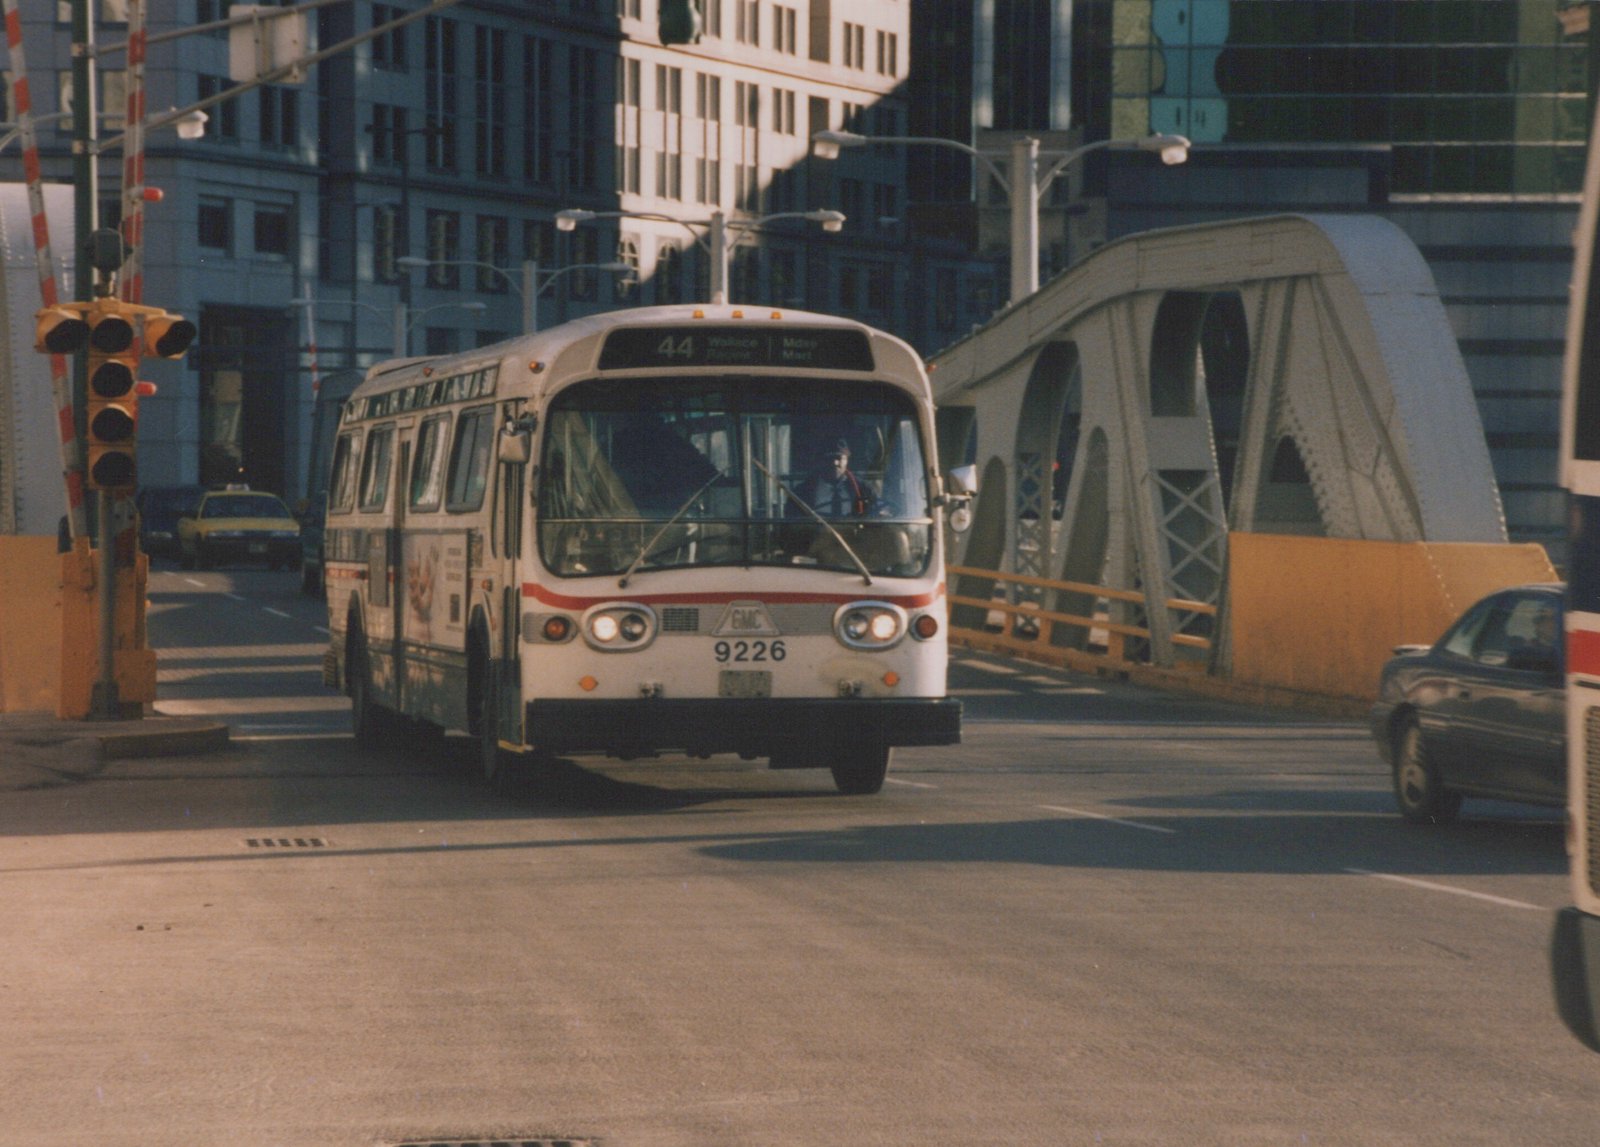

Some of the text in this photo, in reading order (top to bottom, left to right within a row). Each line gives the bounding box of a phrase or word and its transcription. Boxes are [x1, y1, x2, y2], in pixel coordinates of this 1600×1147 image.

[657, 335, 693, 359] 44
[731, 609, 762, 630] GMC
[714, 640, 787, 662] 9226
